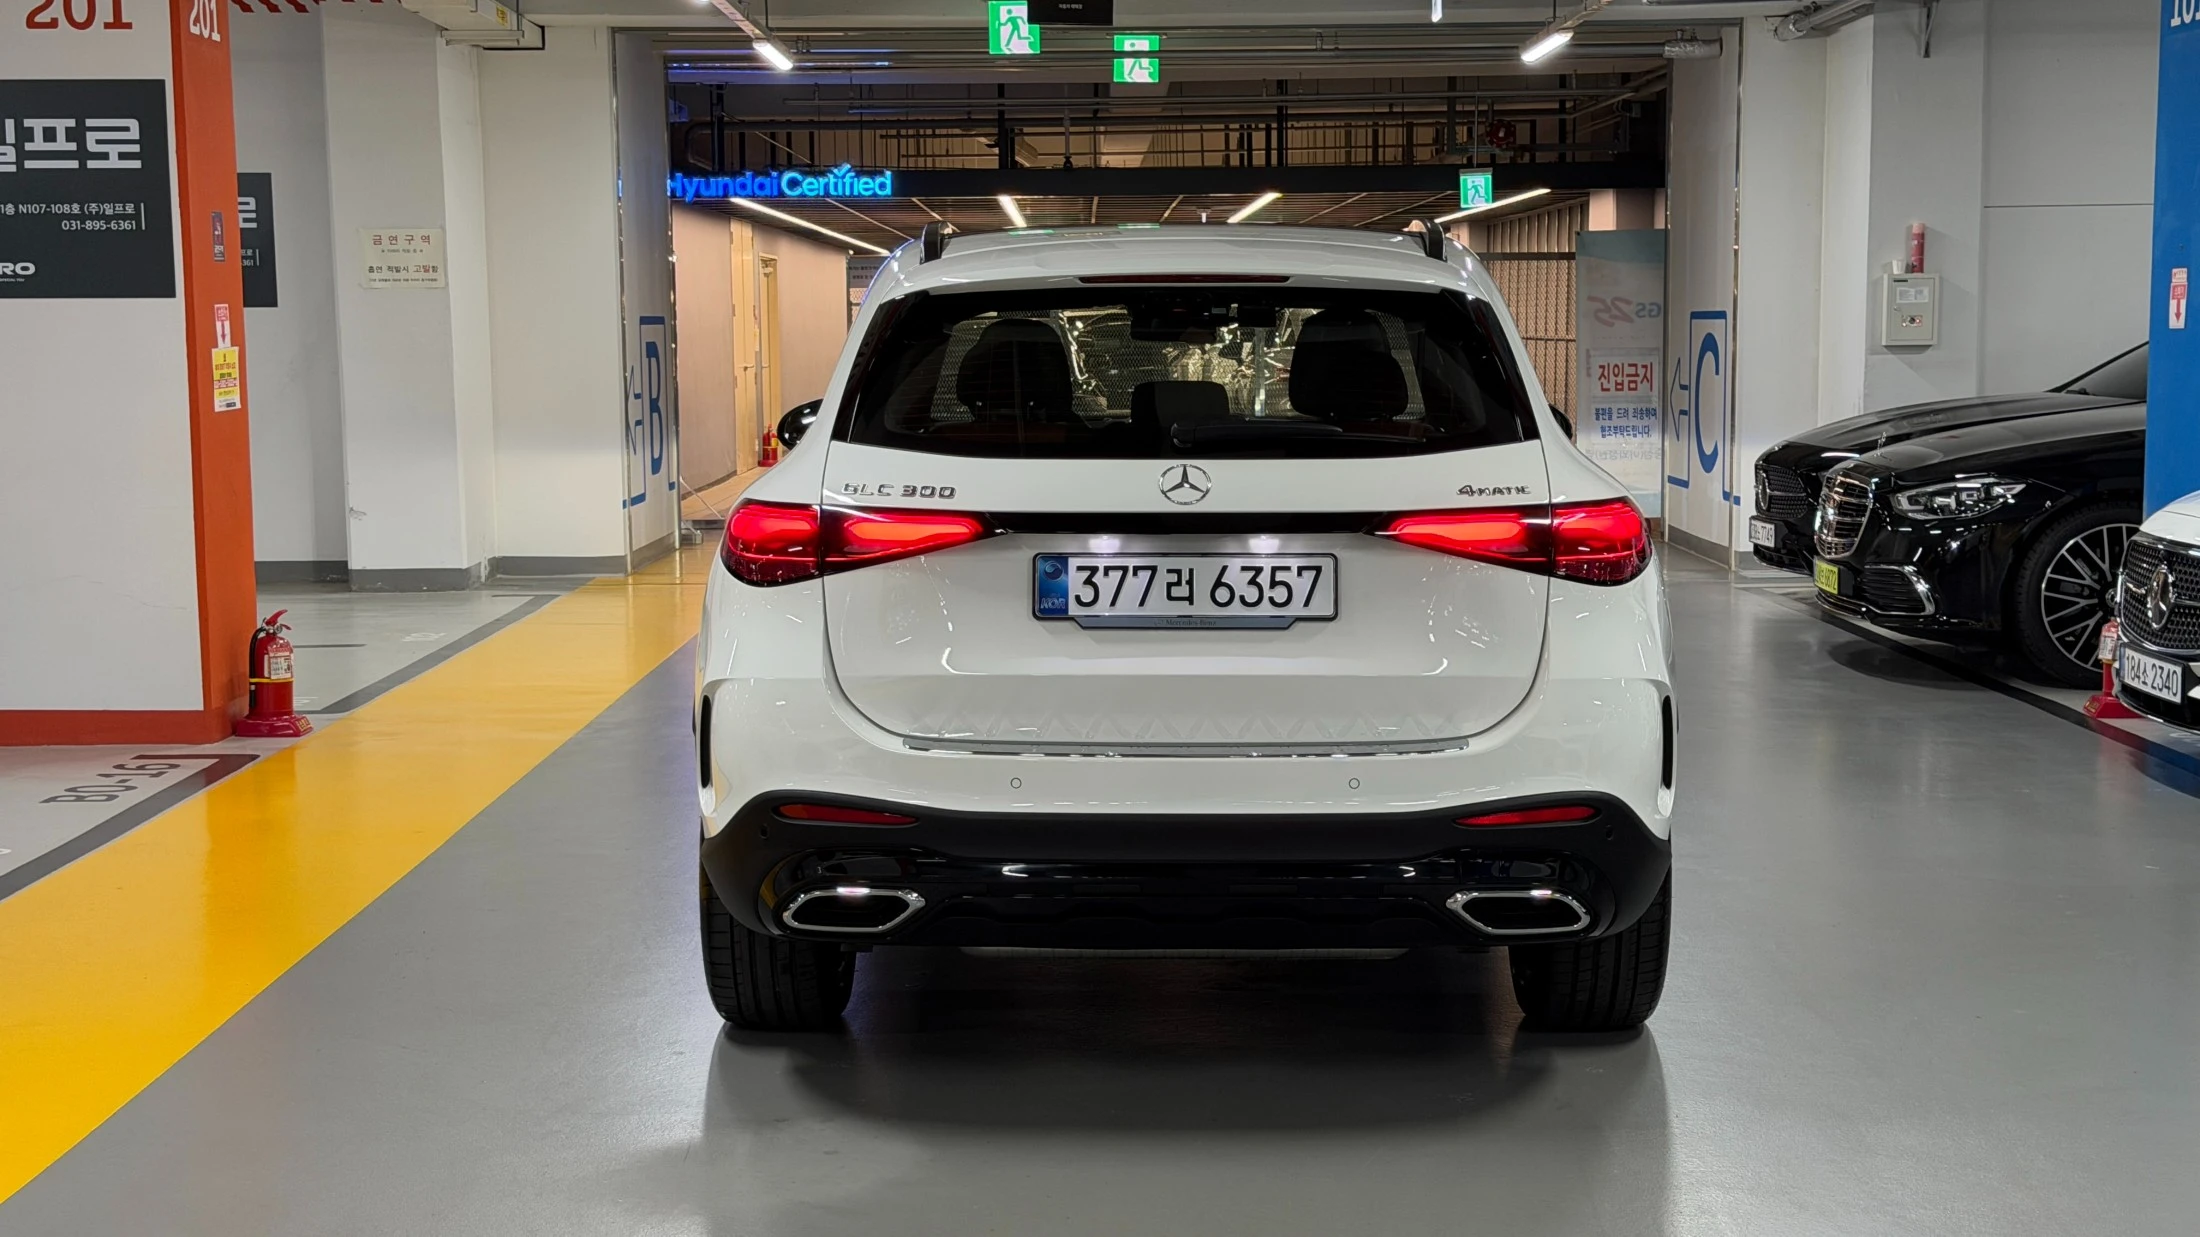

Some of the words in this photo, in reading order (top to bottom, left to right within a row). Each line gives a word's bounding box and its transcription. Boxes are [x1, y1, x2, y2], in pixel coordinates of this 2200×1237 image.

[2170, 0, 2200, 27] 10
[667, 171, 779, 202] Hyundai
[780, 163, 892, 197] Certified
[19, 203, 81, 215] N107-108호
[84, 203, 136, 215] (주)일프로
[61, 220, 136, 231] 031-895-6361
[1598, 361, 1654, 393] 진입금지
[645, 341, 663, 476] B
[1595, 407, 1613, 421] 불편을
[1616, 407, 1629, 421] 드려
[1695, 332, 1720, 474] C
[1600, 424, 1652, 439] 협조부탁드립니다.
[841, 483, 895, 496] GLC
[900, 485, 957, 499] 300
[1074, 564, 1195, 608] 377러
[1209, 564, 1323, 608] 6357
[2151, 662, 2179, 698] 2340
